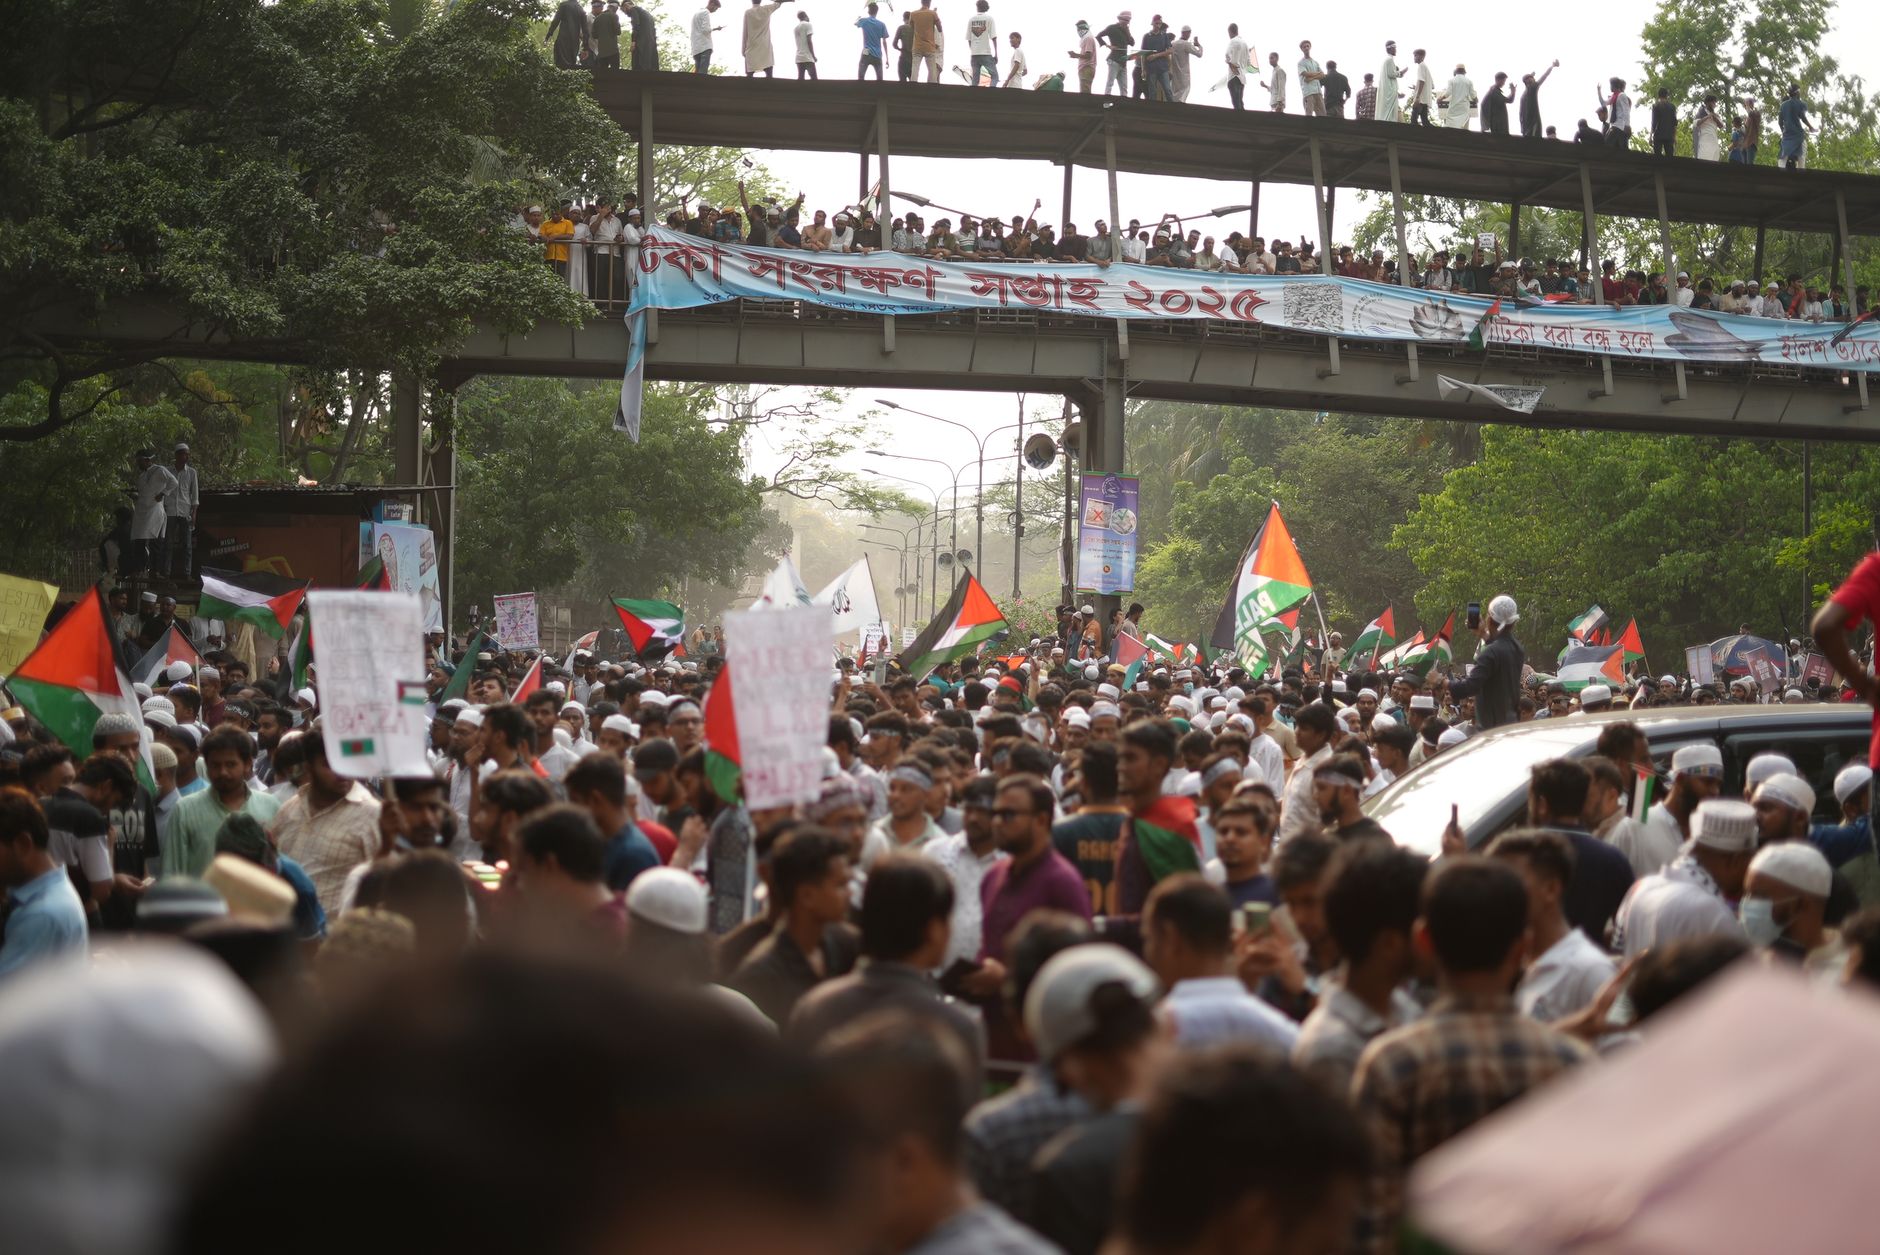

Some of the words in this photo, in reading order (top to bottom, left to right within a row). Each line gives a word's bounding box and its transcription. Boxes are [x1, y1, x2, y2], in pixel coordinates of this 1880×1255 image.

[740, 251, 946, 300] সংরক্ষণ
[963, 271, 1108, 310] সপ্তাহ
[1123, 279, 1271, 323] ২০২৫
[1543, 323, 1574, 349] ধরা
[1580, 327, 1611, 352] বন্ধ
[1616, 330, 1654, 354] হলে
